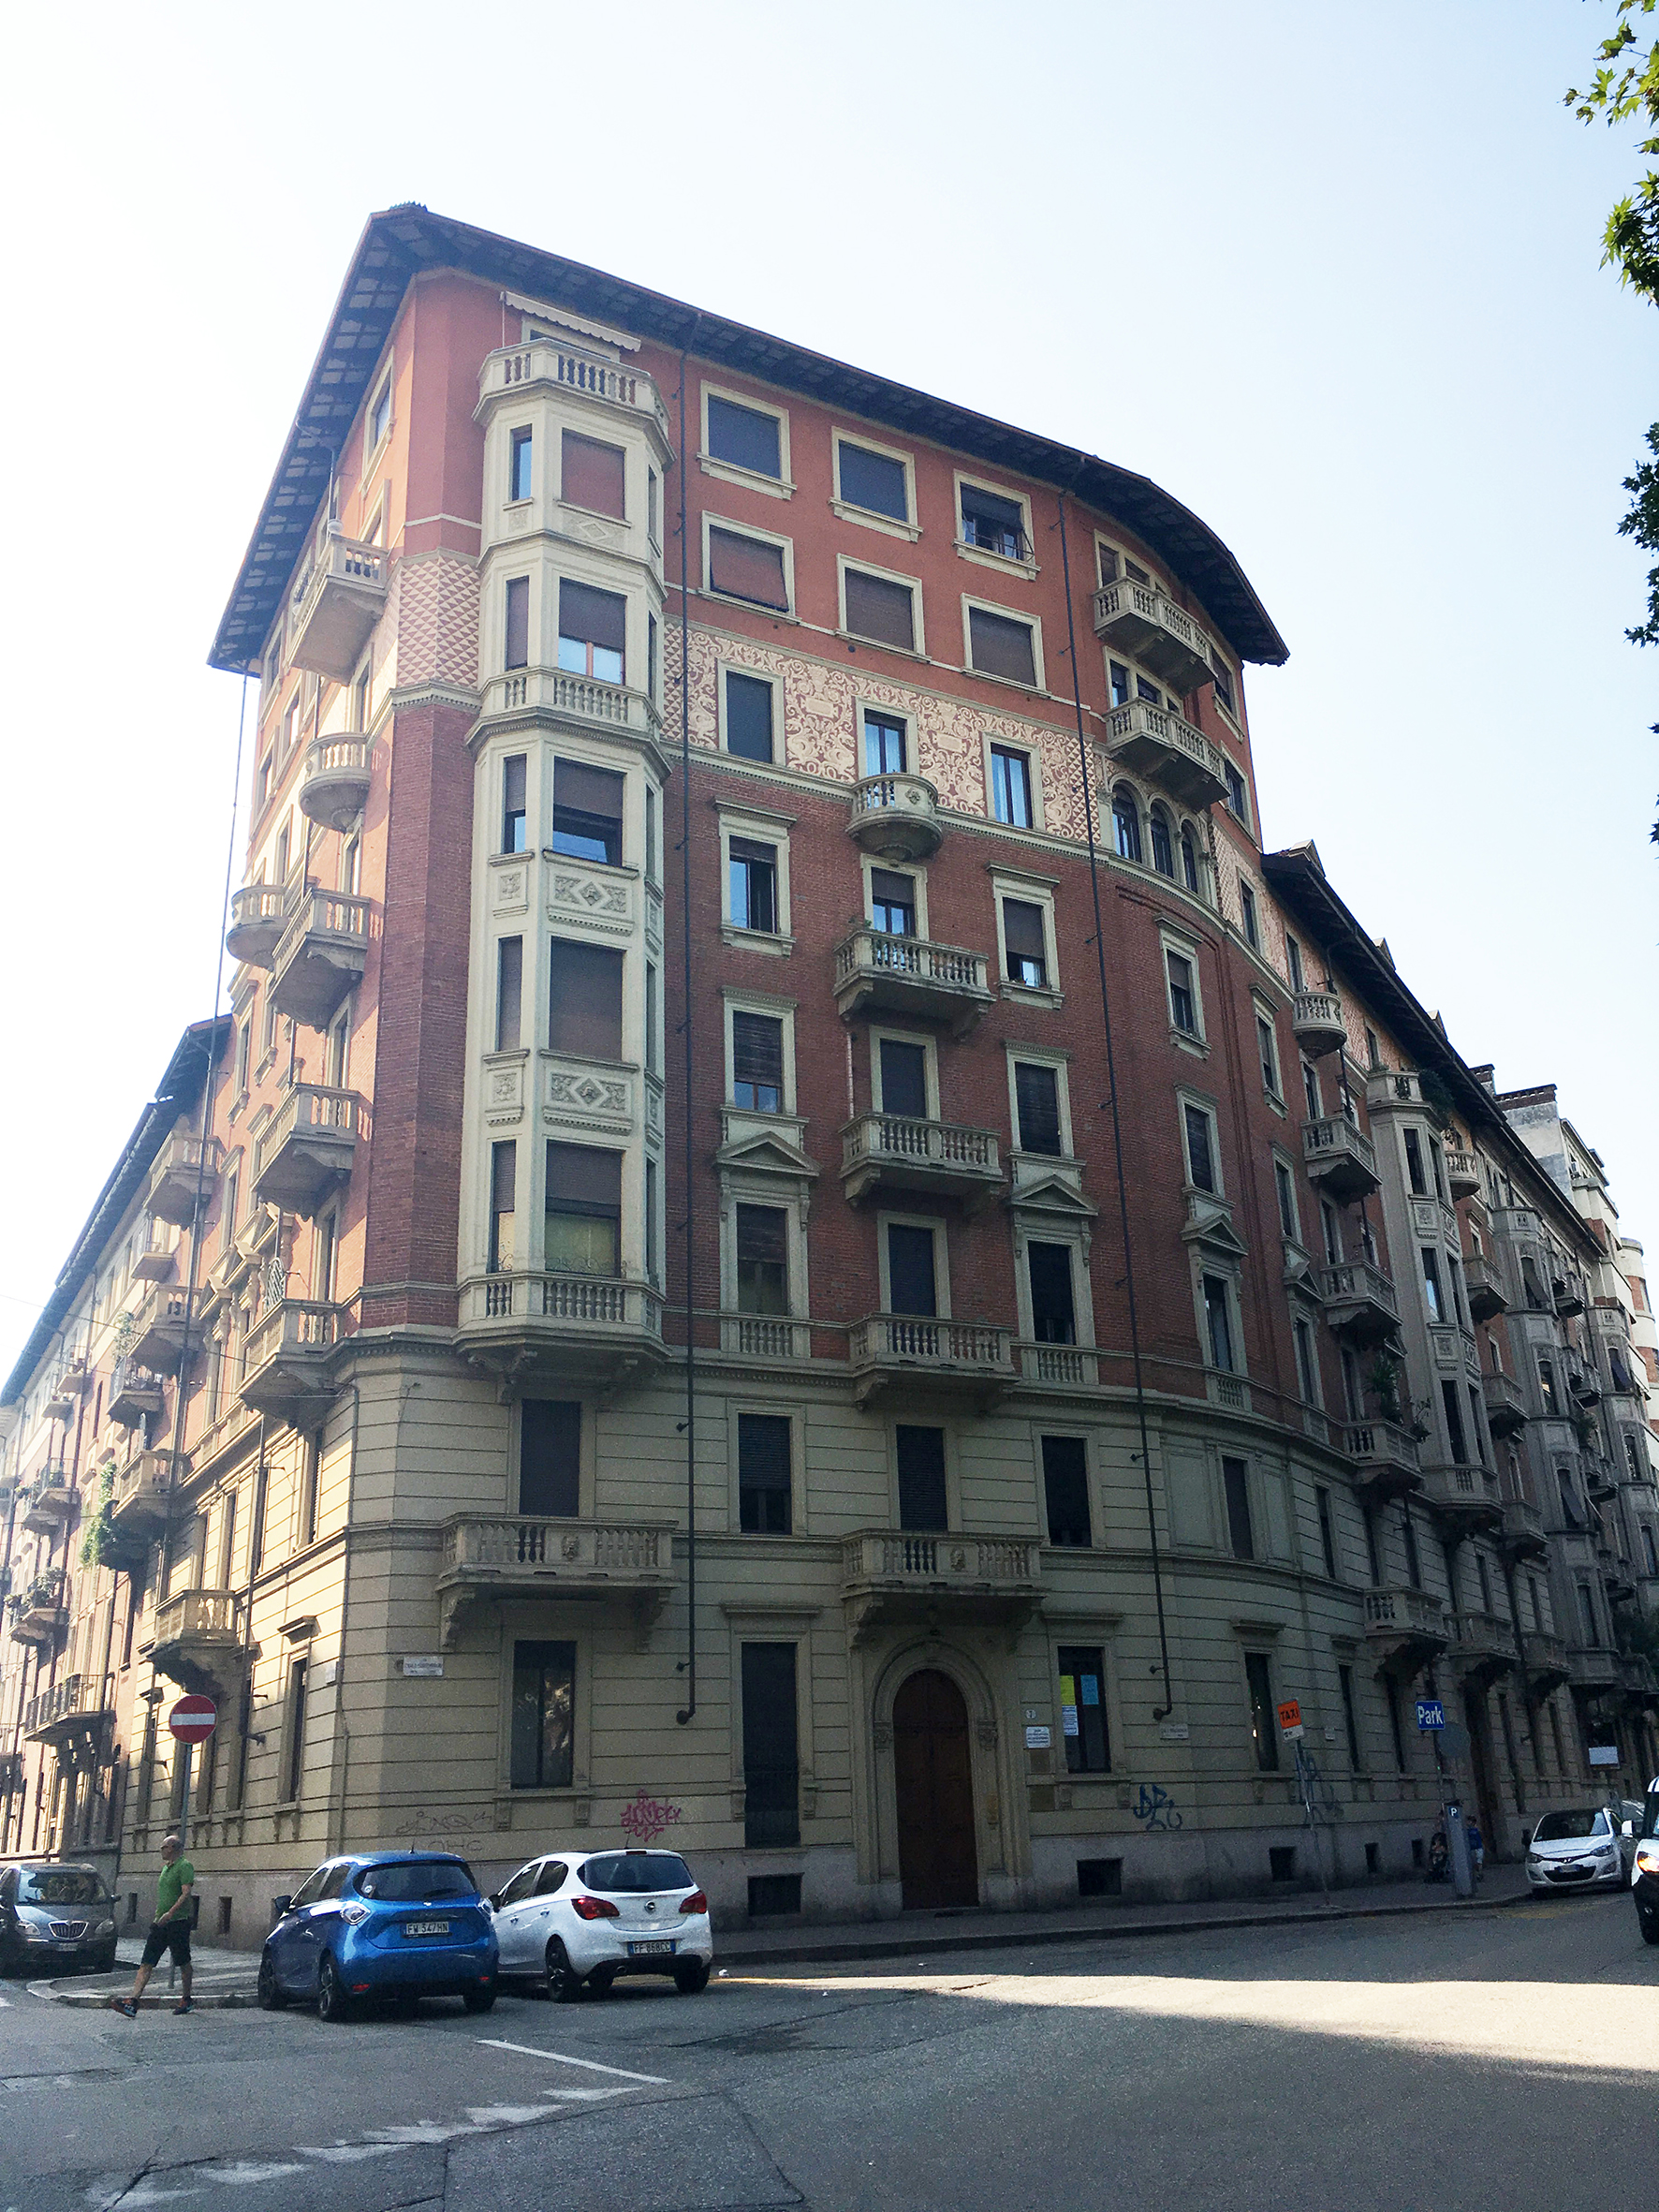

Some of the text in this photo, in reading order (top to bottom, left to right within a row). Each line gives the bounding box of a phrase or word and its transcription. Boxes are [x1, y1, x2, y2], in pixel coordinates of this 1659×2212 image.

[1280, 1707, 1299, 1721] TAXI
[1417, 1705, 1444, 1724] Park
[1450, 1807, 1458, 1817] P
